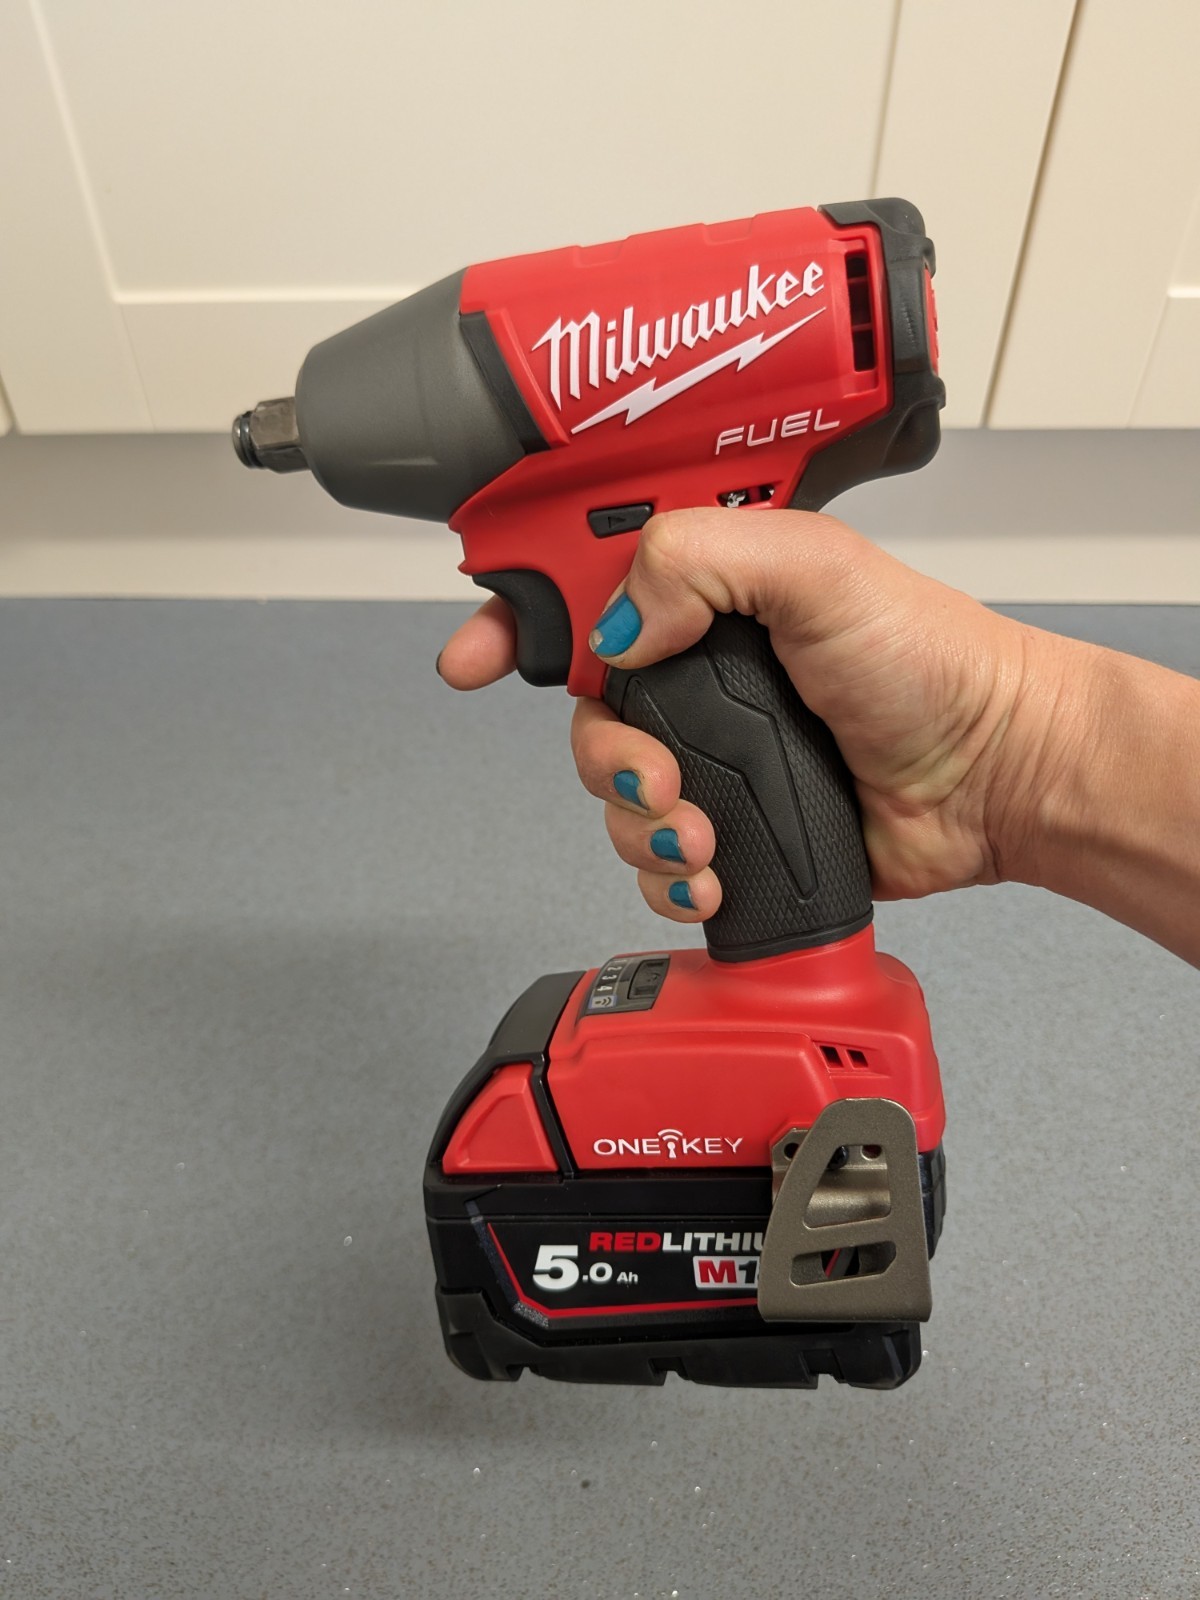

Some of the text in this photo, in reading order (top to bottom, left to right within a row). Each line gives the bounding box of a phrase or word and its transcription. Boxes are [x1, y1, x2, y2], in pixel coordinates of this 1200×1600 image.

[531, 261, 825, 411] Milwaukee
[714, 407, 841, 456] FUEL
[593, 1137, 744, 1156] ONE KEY
[532, 1244, 639, 1291] 5.0 Ah
[697, 1259, 760, 1285] M1
